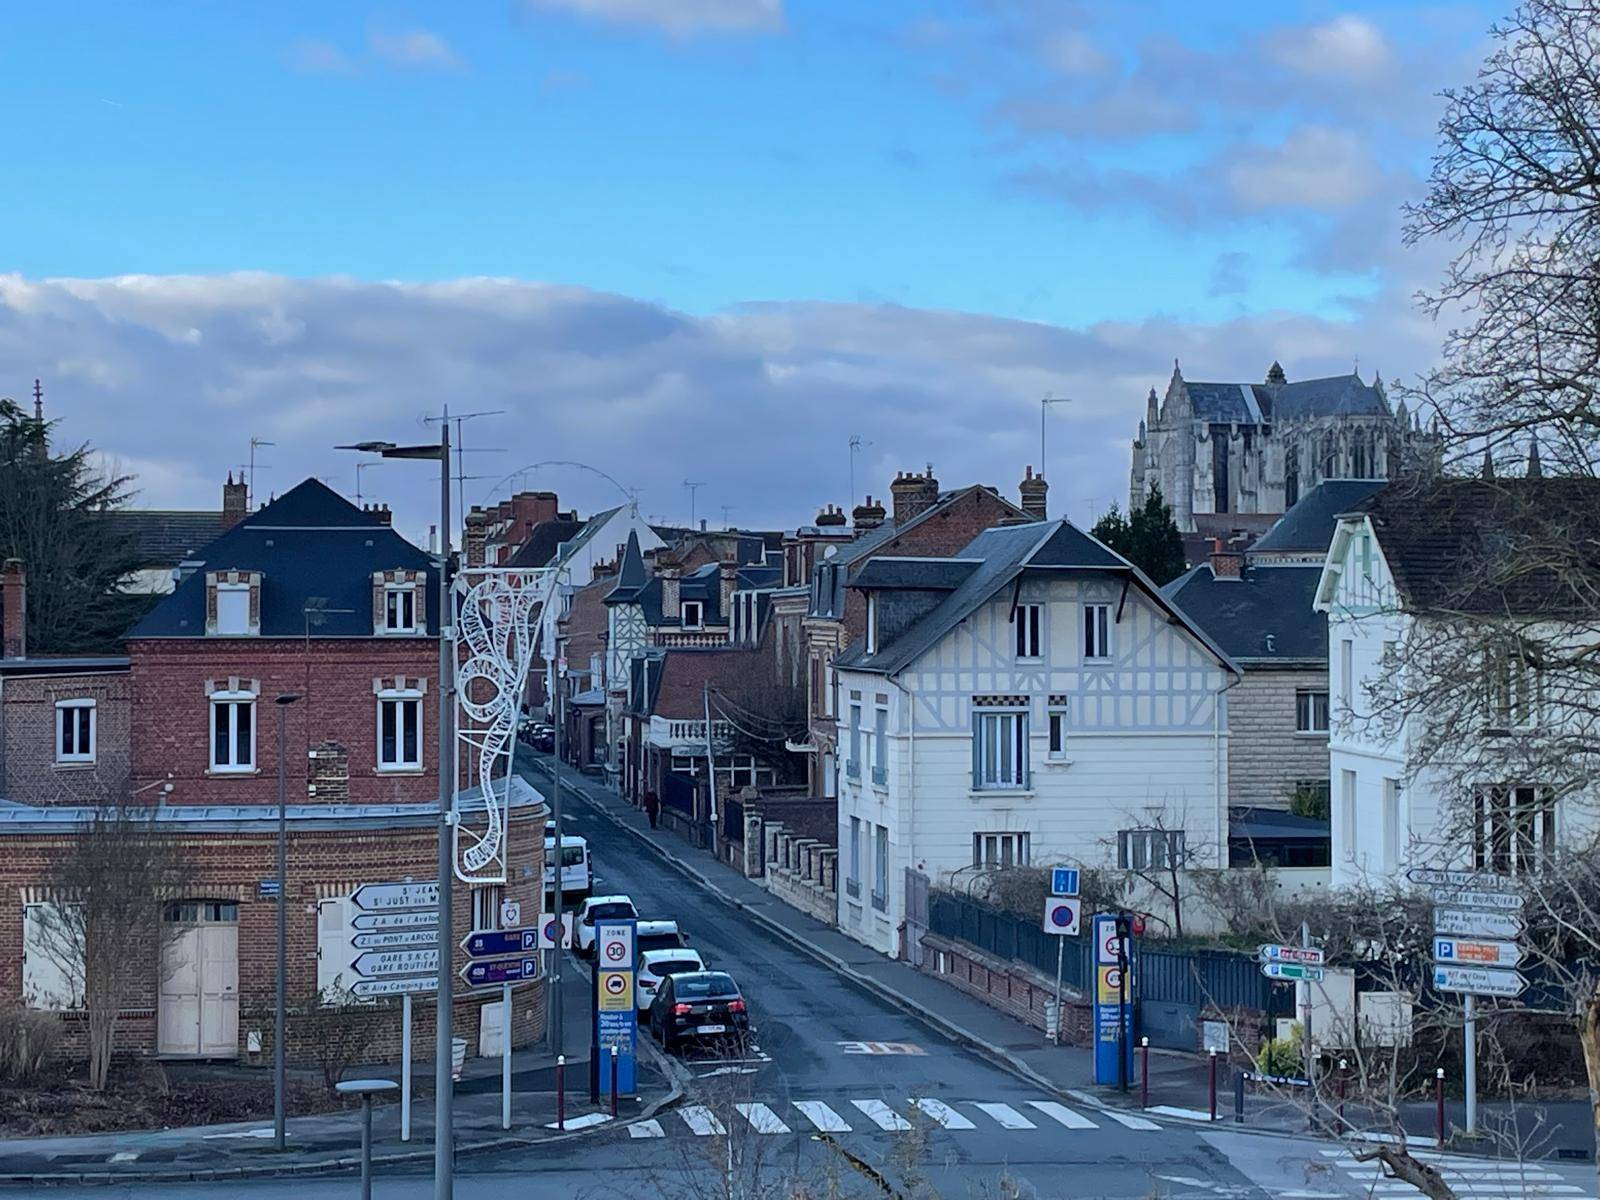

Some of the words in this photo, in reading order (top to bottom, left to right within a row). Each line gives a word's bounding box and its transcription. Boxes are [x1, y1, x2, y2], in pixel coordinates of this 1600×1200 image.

[386, 896, 410, 906] JUST
[383, 935, 403, 943] PONT
[610, 947, 623, 957] 30
[1440, 943, 1451, 957] P
[380, 954, 403, 962] GARE
[370, 965, 393, 973] GARE
[372, 984, 388, 992] Aire
